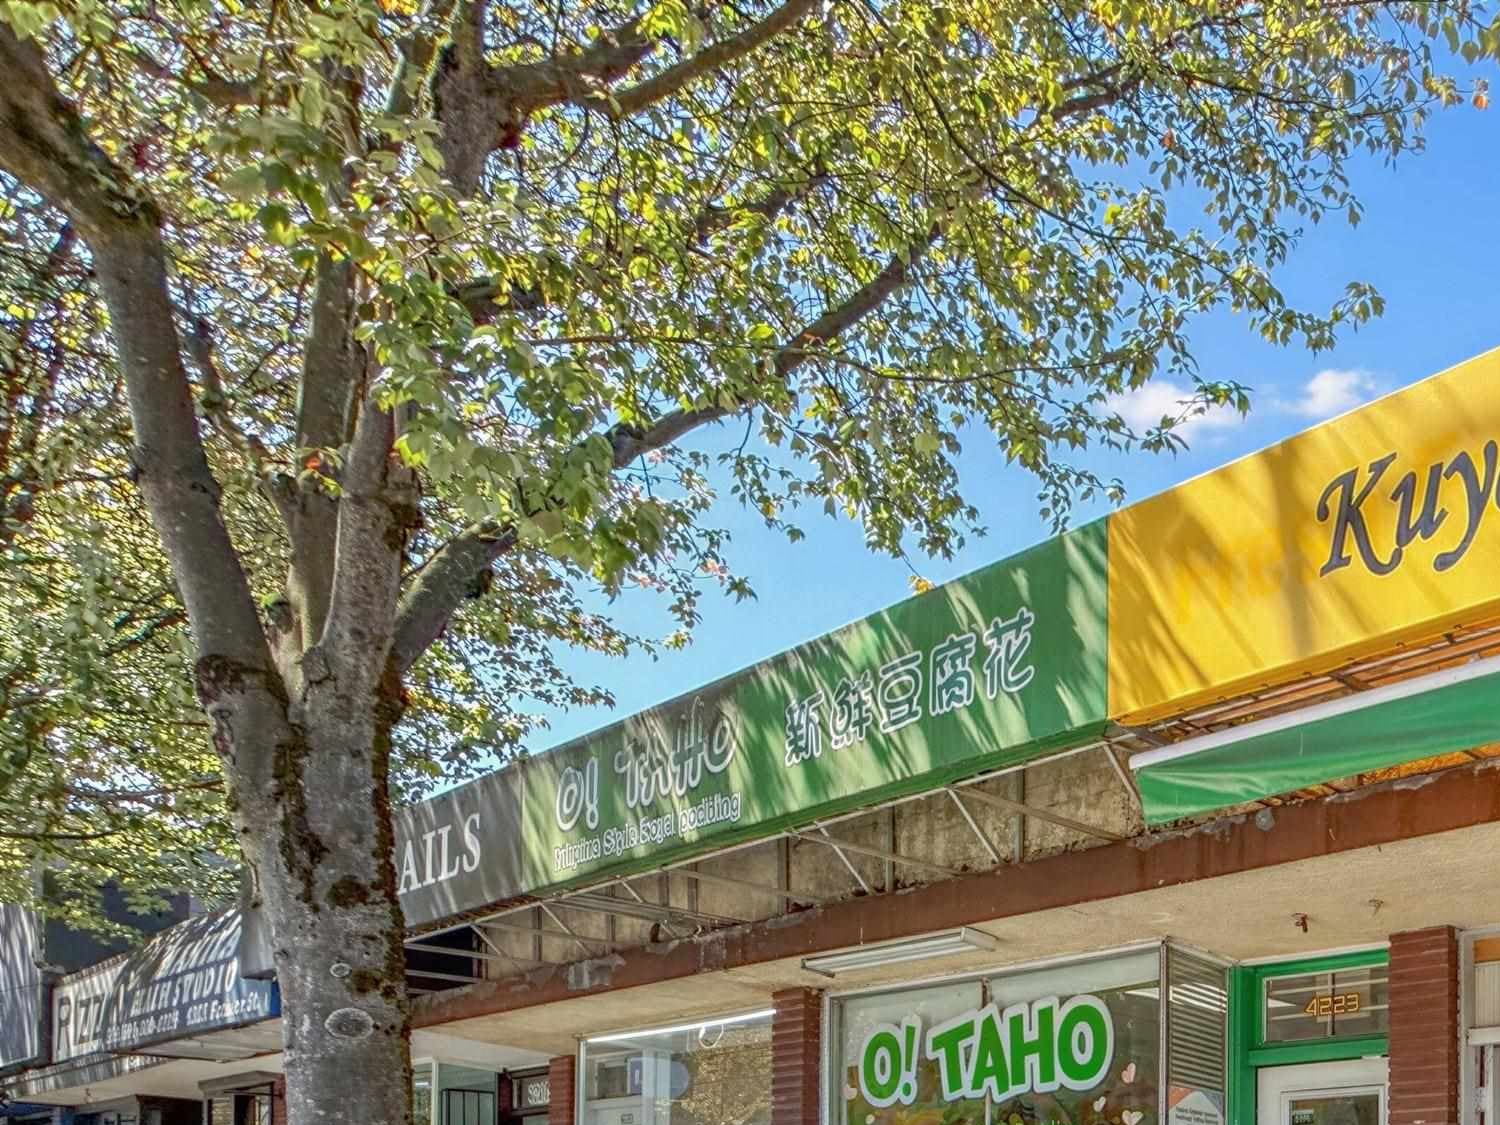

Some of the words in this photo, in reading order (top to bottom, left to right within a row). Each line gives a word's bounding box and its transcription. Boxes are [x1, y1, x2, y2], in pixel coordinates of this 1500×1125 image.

[1304, 992, 1360, 1016] 4223
[860, 1018, 920, 1106] O!
[927, 996, 1114, 1103] TAHO
